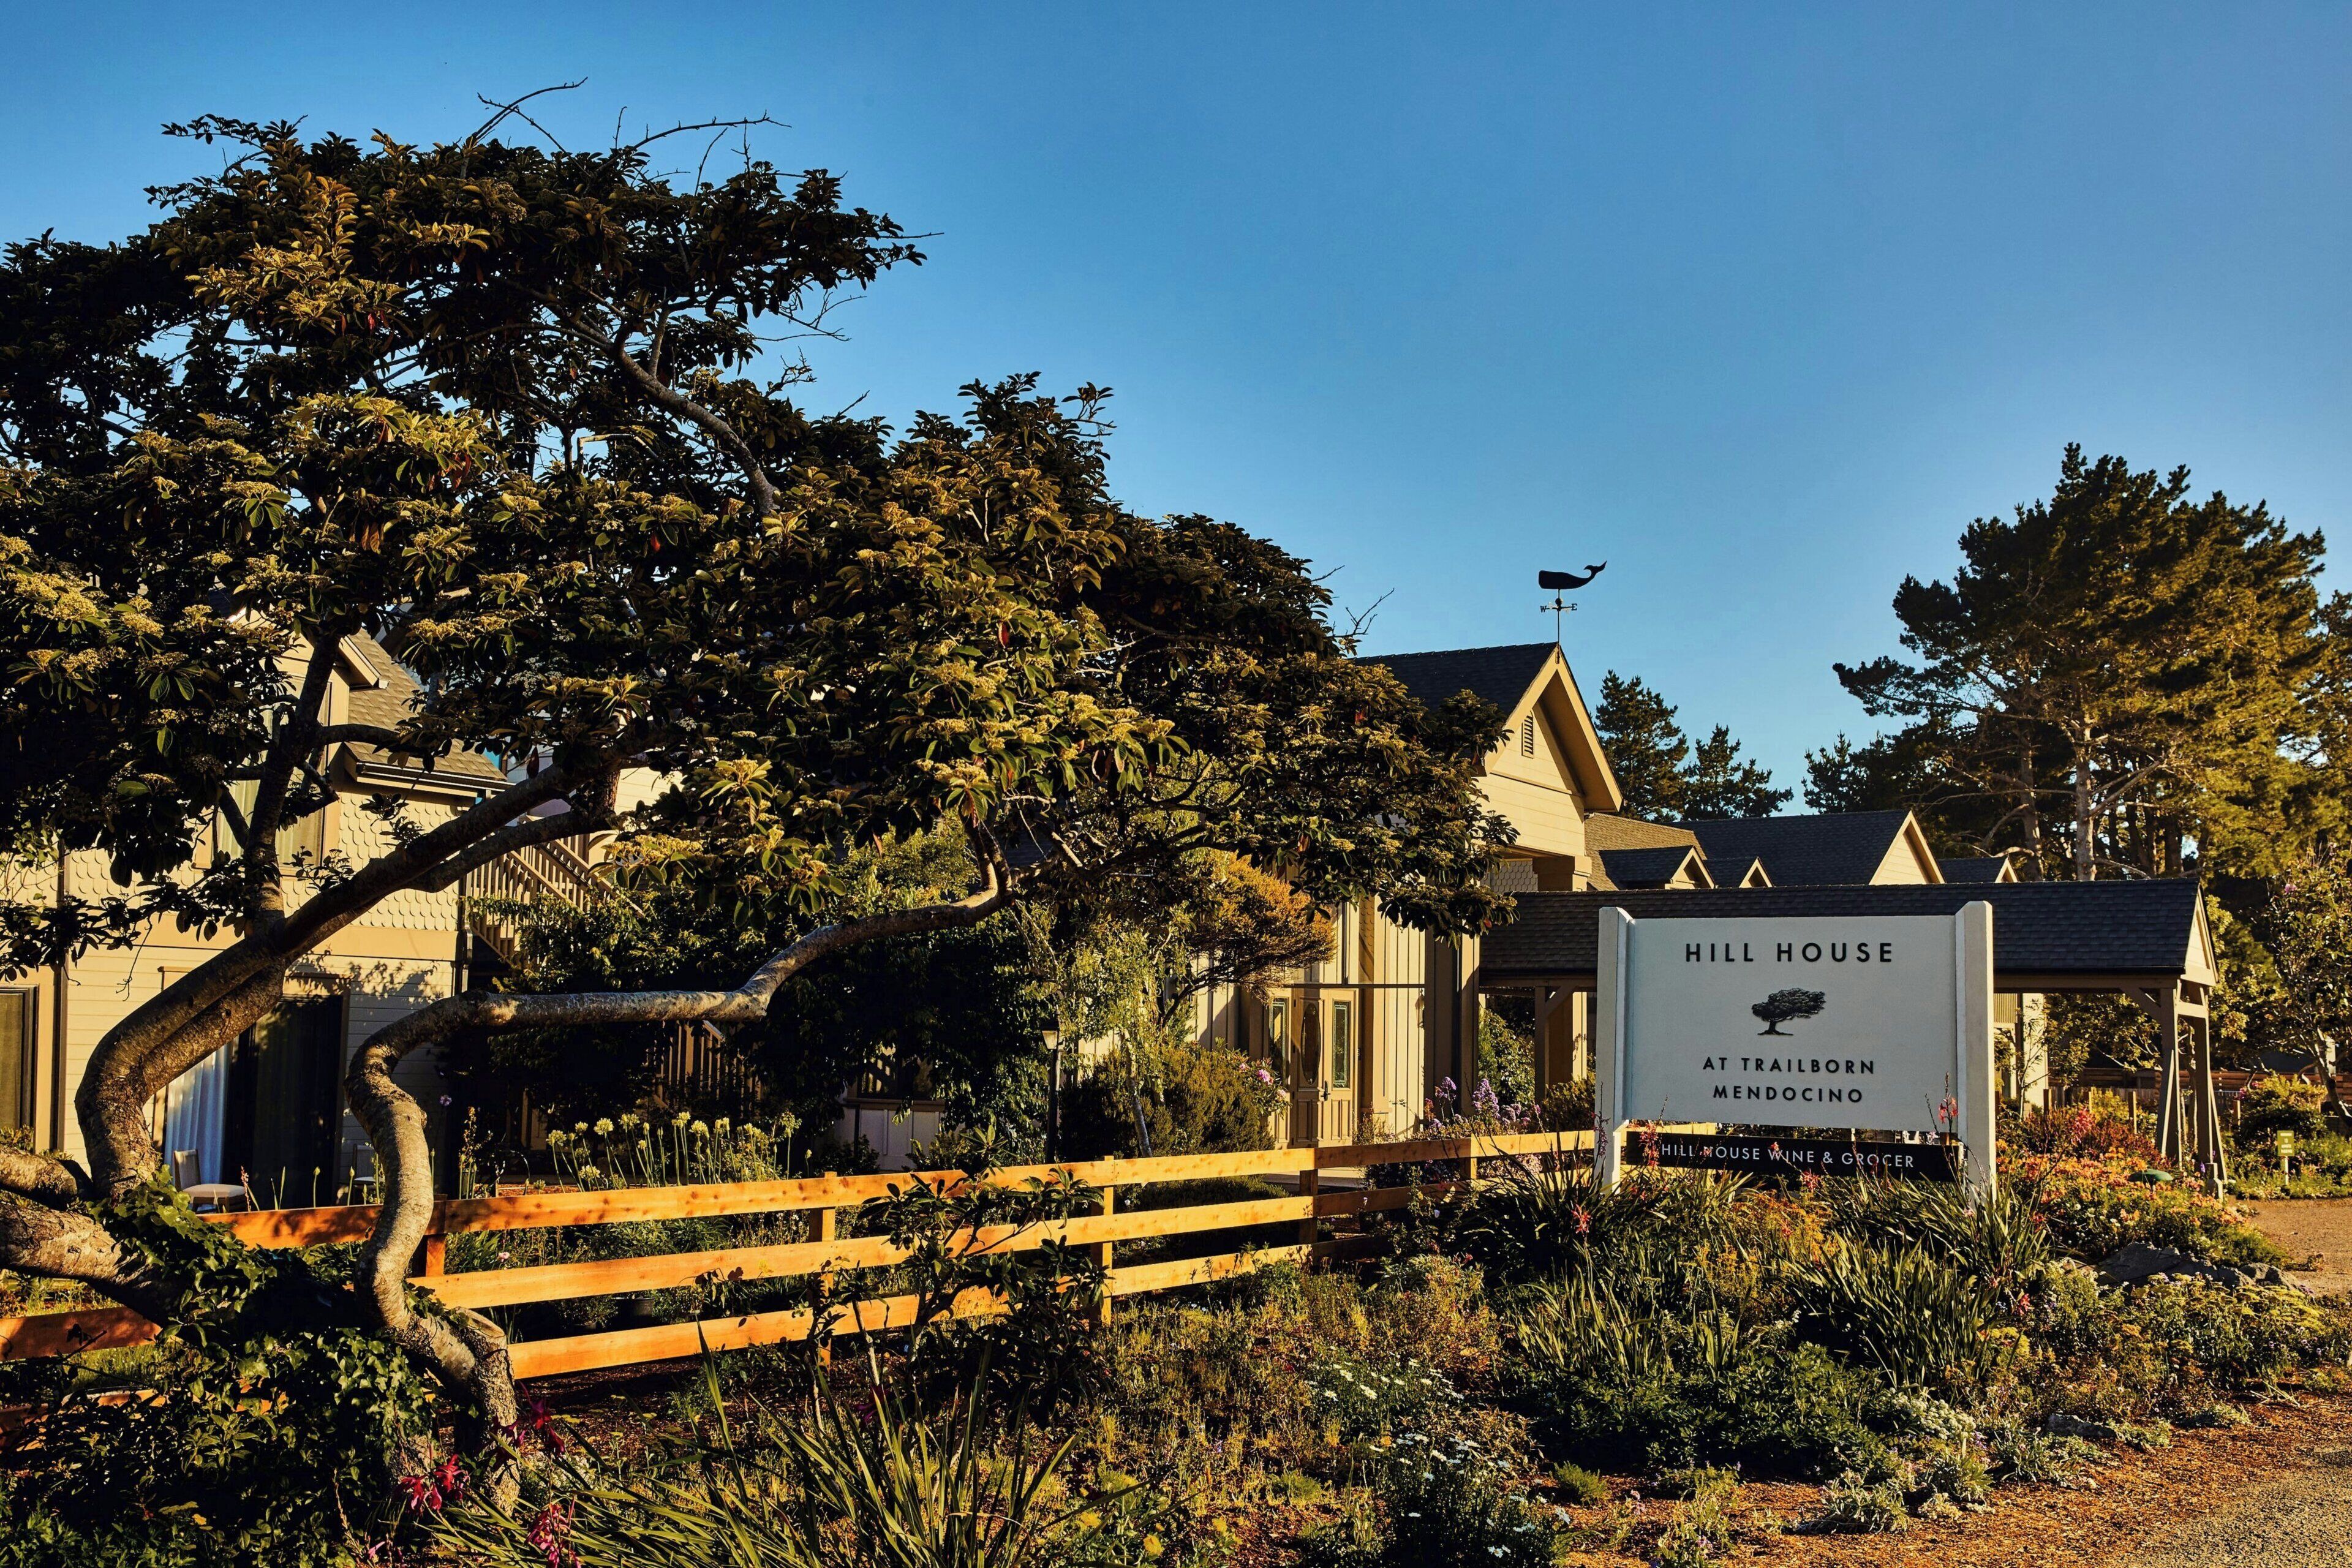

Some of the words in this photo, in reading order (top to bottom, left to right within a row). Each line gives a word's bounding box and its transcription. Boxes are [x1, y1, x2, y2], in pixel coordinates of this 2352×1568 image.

[1686, 943, 1754, 963] HILL
[1777, 942, 1893, 963] HOUSE
[1702, 1057, 1728, 1071] AT
[1741, 1057, 1874, 1075] TRAILBORN
[1713, 1085, 1863, 1103] MENDOCINO
[1662, 1144, 1696, 1156] HILL
[1768, 1149, 1814, 1163] WINE
[1823, 1152, 1833, 1164] &
[1841, 1153, 1913, 1167] GROCER
